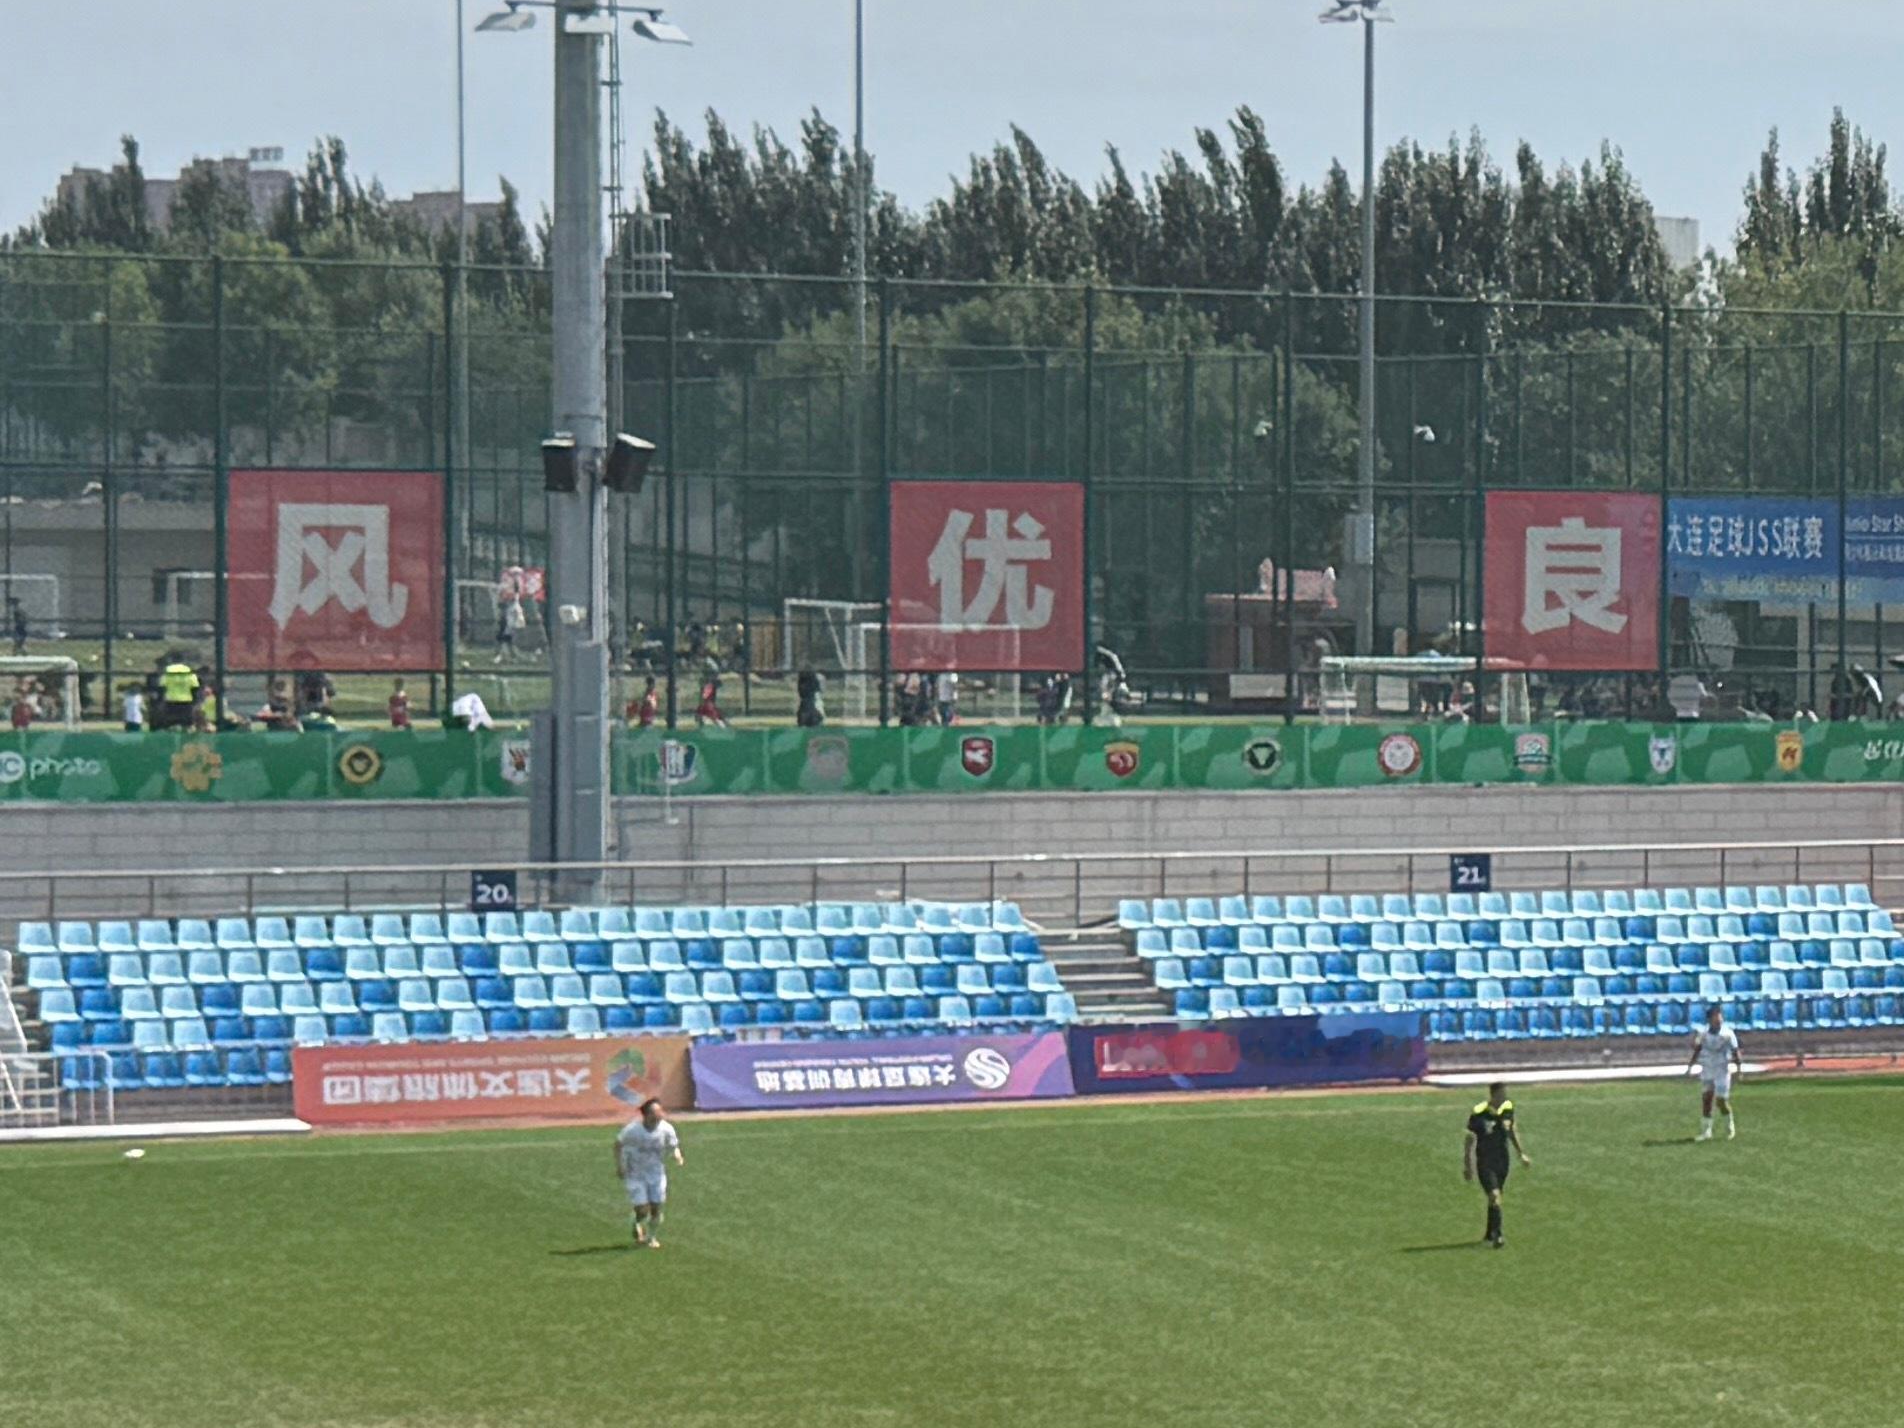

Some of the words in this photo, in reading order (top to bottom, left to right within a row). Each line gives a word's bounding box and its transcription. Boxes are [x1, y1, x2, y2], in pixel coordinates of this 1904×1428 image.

[268, 502, 408, 632] 风
[928, 508, 1055, 634] 优
[1521, 516, 1628, 635] 良
[1667, 514, 1823, 559] 大连足球JSS联赛
[476, 883, 509, 903] 20
[1457, 866, 1480, 884] 21
